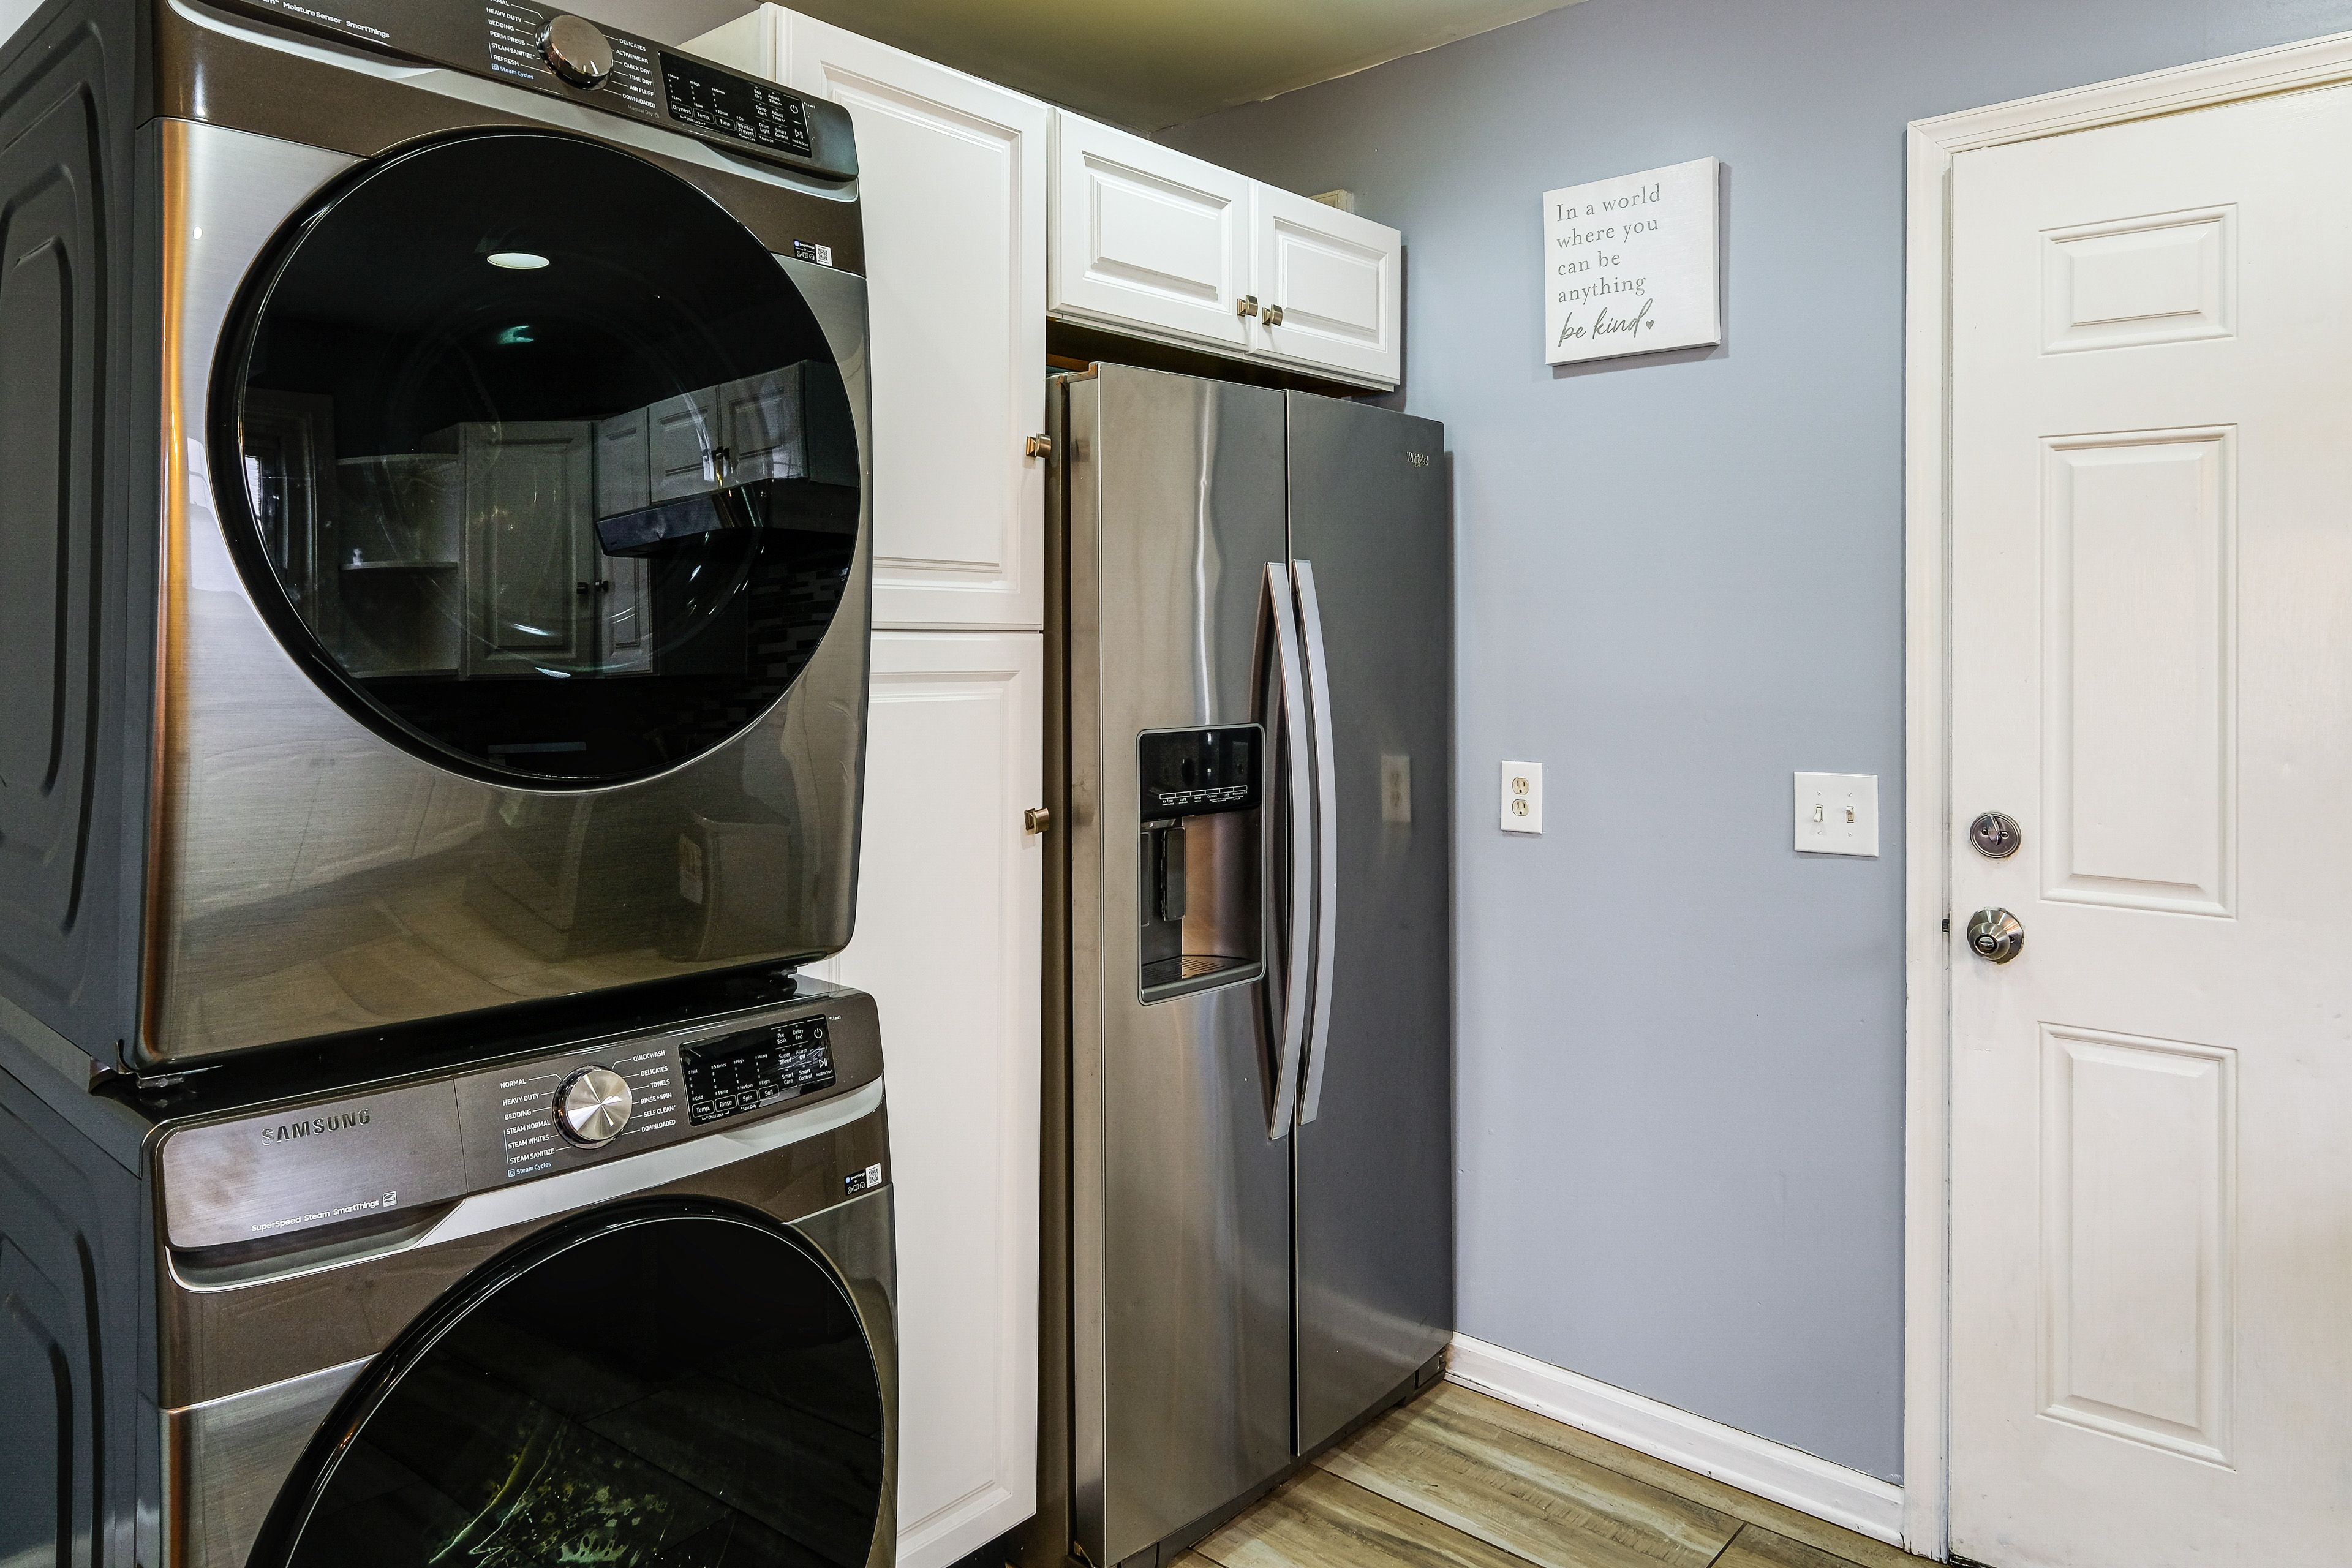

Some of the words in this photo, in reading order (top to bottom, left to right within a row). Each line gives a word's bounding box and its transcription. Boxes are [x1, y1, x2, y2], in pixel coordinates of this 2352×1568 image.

[283, 2, 315, 17] Moisture
[316, 12, 342, 24] Sensor
[346, 20, 390, 38] SmartThings
[486, 7, 505, 17] HEAVY
[507, 13, 522, 23] DUTY
[488, 19, 514, 31] BEDDING
[490, 31, 507, 40] PERM
[507, 36, 526, 45] PRESS
[491, 43, 510, 52] STEAM
[619, 39, 646, 51] DELICATES
[493, 54, 519, 66] REFRESH
[616, 49, 648, 64] ACTIVEWEAR
[500, 66, 517, 75] Steam
[518, 71, 534, 80] Cycles
[624, 62, 639, 72] QUICK
[629, 74, 641, 83] TIME
[639, 88, 654, 97] FLUFF
[622, 93, 656, 108] DOWNLOADED
[673, 104, 692, 115] Dryness
[697, 112, 710, 121] Temp.
[737, 123, 753, 132] Wrinkle
[1556, 204, 1578, 222] In
[1586, 205, 1594, 216] a
[1602, 183, 1661, 212] world
[1557, 227, 1615, 249] where
[1623, 219, 1659, 243] you
[1558, 259, 1590, 276] can
[1597, 250, 1621, 268] be
[1558, 277, 1646, 305] anything
[1558, 312, 1586, 348] be
[1593, 298, 1653, 340] kind
[633, 1054, 649, 1062] QUICK
[641, 1066, 668, 1077] DELICATES
[500, 1078, 527, 1089] NORMAL
[650, 1079, 670, 1088] TOWELS
[502, 1096, 522, 1106] HEAVY
[524, 1093, 540, 1102] DUTY
[641, 1095, 656, 1104] RINSE
[504, 1109, 532, 1120] BEDDING
[643, 1109, 656, 1118] SELF
[262, 1107, 371, 1145] SAMSUNG
[506, 1125, 526, 1135] STEAM
[526, 1119, 551, 1131] NORMAL
[641, 1119, 676, 1133] DOWNLOADED
[508, 1139, 528, 1149] STEAM
[528, 1134, 549, 1145] WHITES
[510, 1154, 529, 1164] STEAM
[530, 1148, 555, 1159] SANITIZE
[516, 1166, 534, 1175] Steam
[534, 1161, 552, 1171] Cycles
[252, 1216, 301, 1232] SuperSpeed
[304, 1210, 330, 1222] Steam
[333, 1199, 379, 1215] SmartThings
